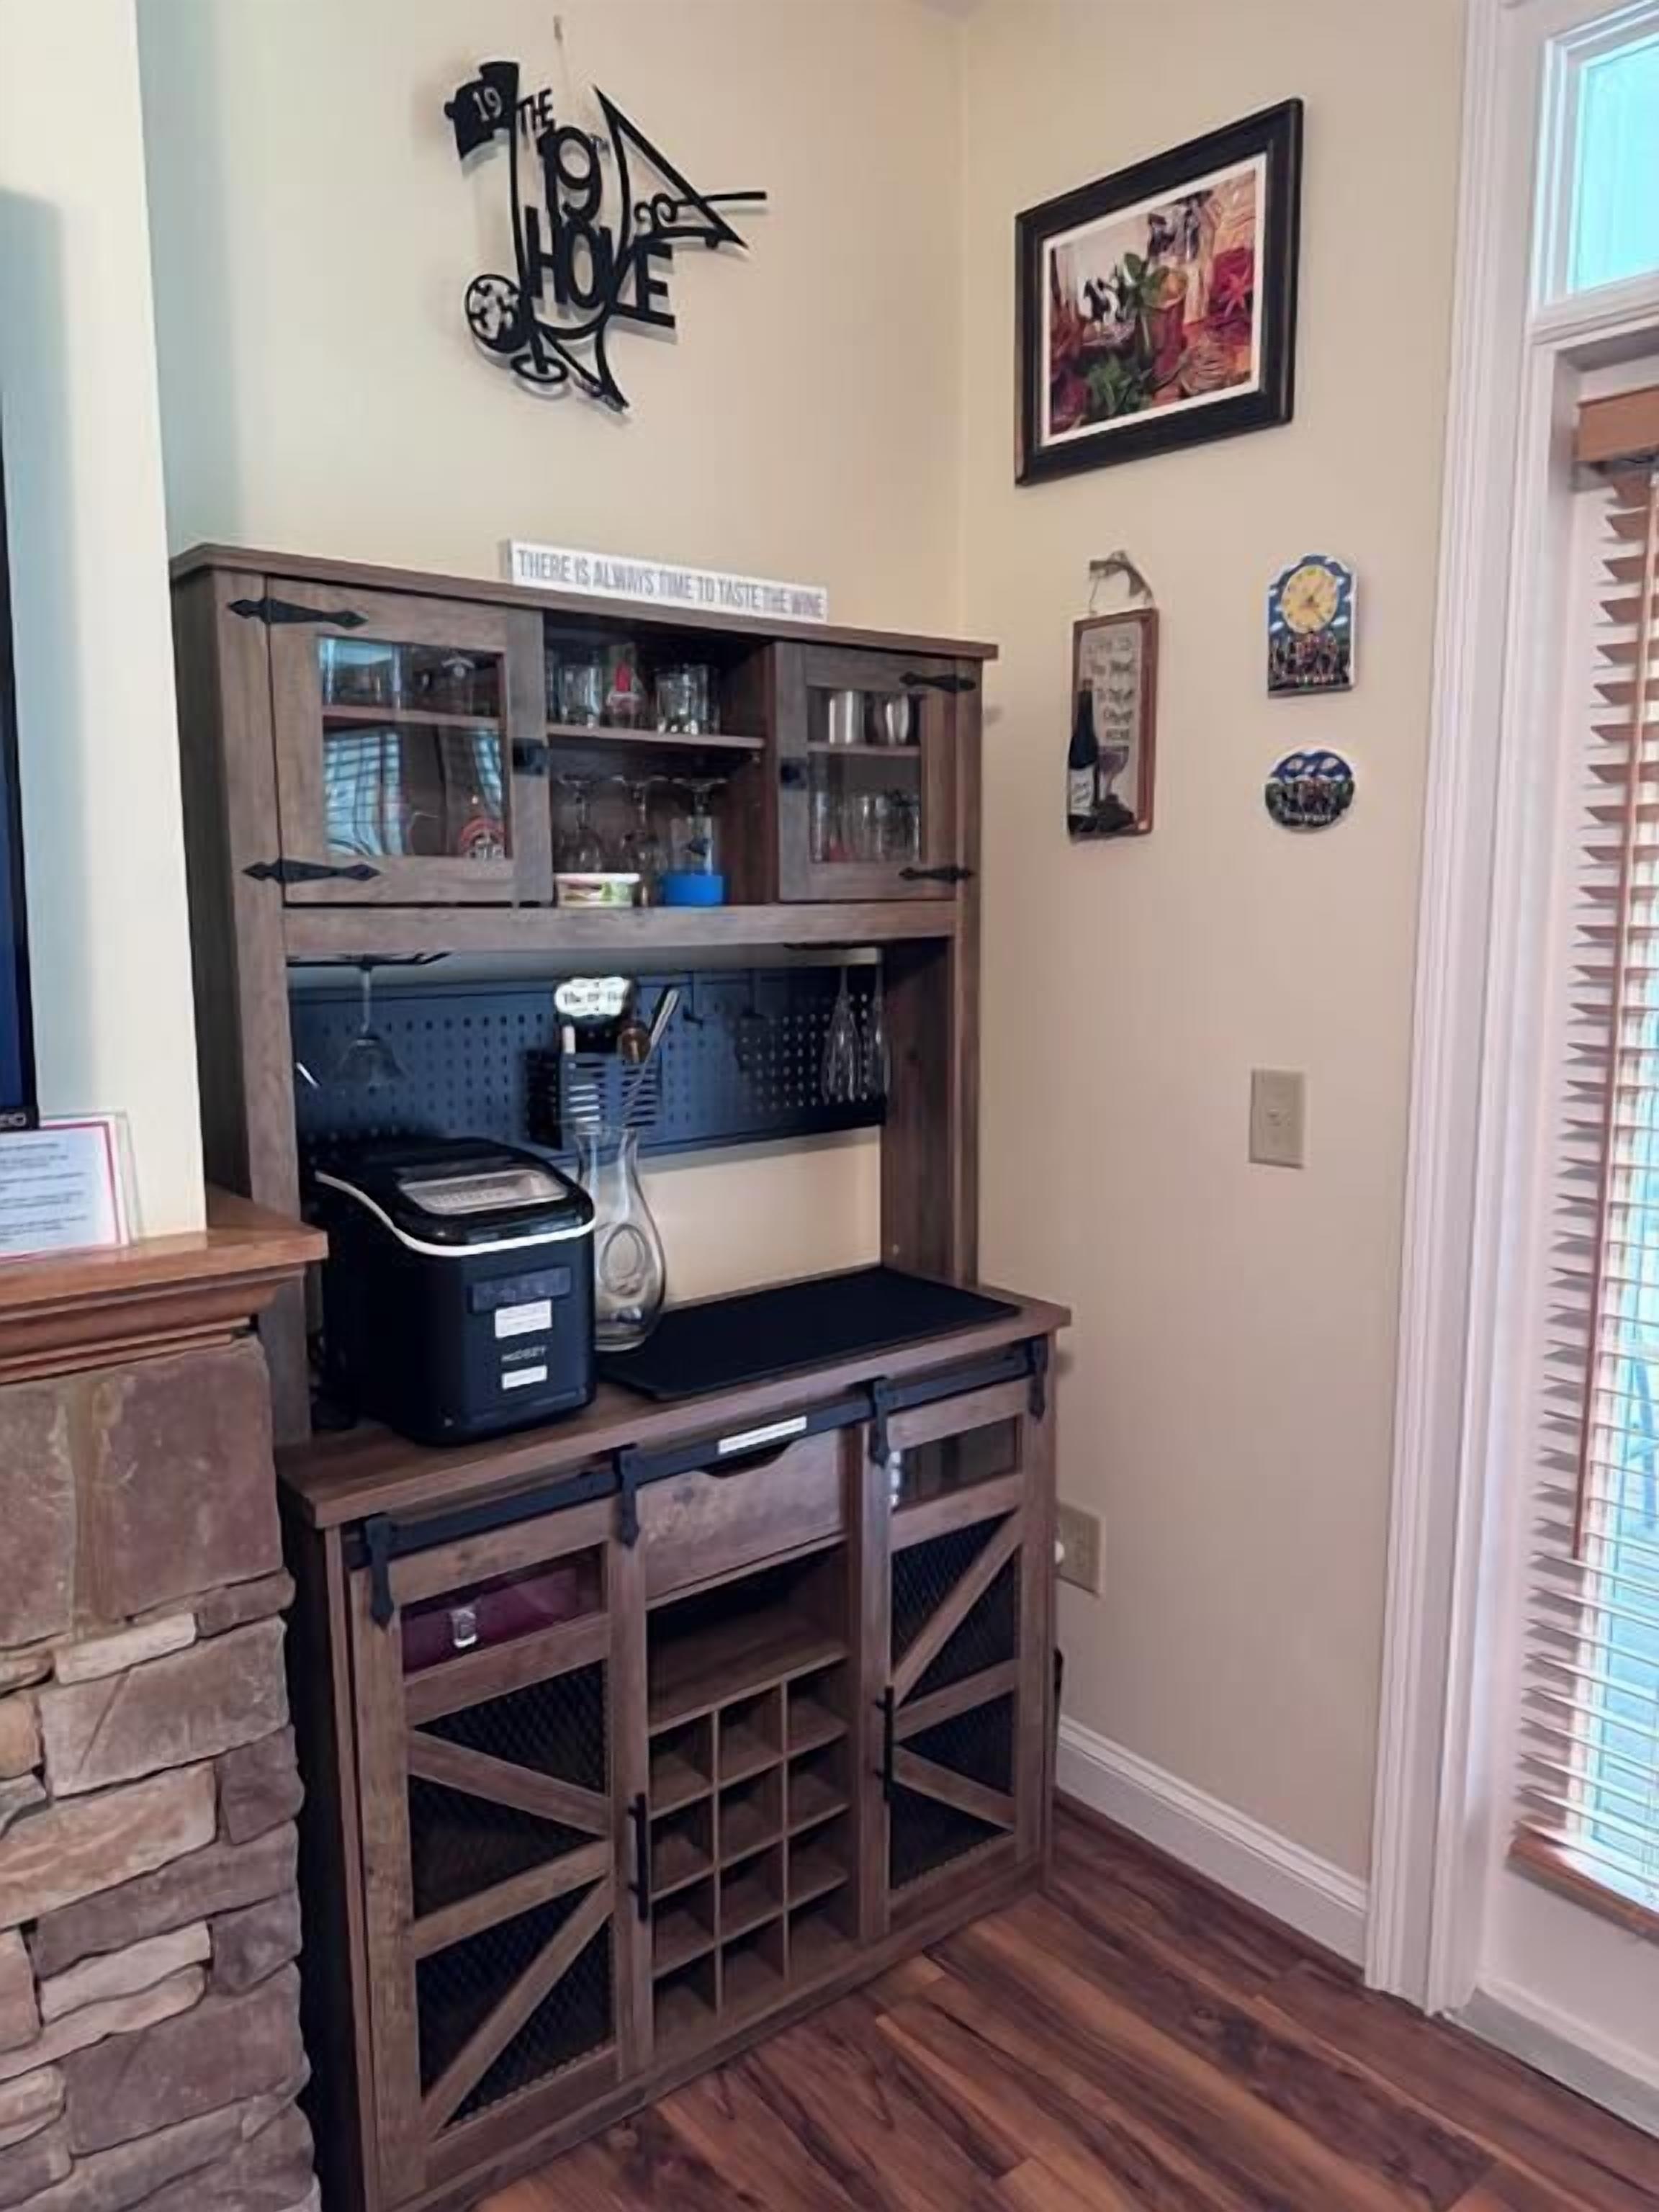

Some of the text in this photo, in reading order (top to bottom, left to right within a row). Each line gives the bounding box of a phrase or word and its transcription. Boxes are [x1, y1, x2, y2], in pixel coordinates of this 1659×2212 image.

[472, 87, 502, 121] 19
[516, 87, 555, 138] THE
[525, 204, 675, 329] HOLE
[518, 549, 825, 621] THERE IS ALWAYS TIME TO TASTE THE WINE
